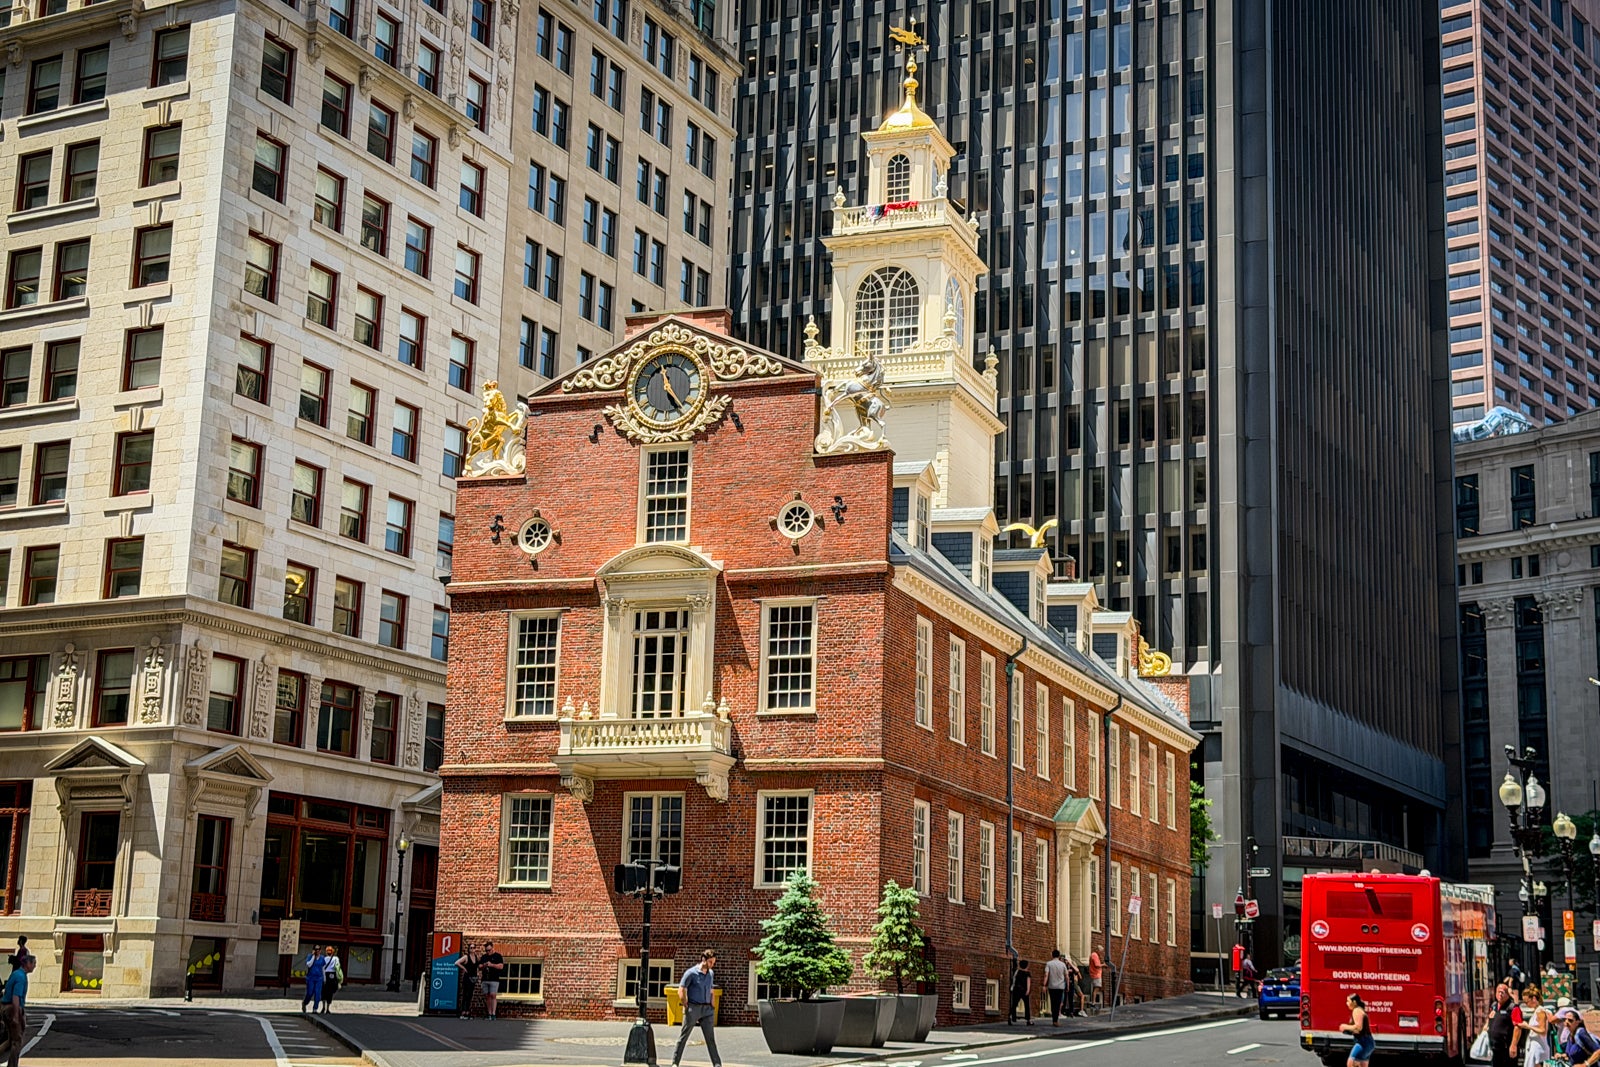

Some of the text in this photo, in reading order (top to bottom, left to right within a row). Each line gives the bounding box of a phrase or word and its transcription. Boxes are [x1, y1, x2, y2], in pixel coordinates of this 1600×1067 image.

[442, 935, 451, 954] R
[1318, 945, 1422, 955] WWW.BOSTONSIGHTSEEING.US
[1332, 971, 1411, 981] BOSTON SIGHTSEEING
